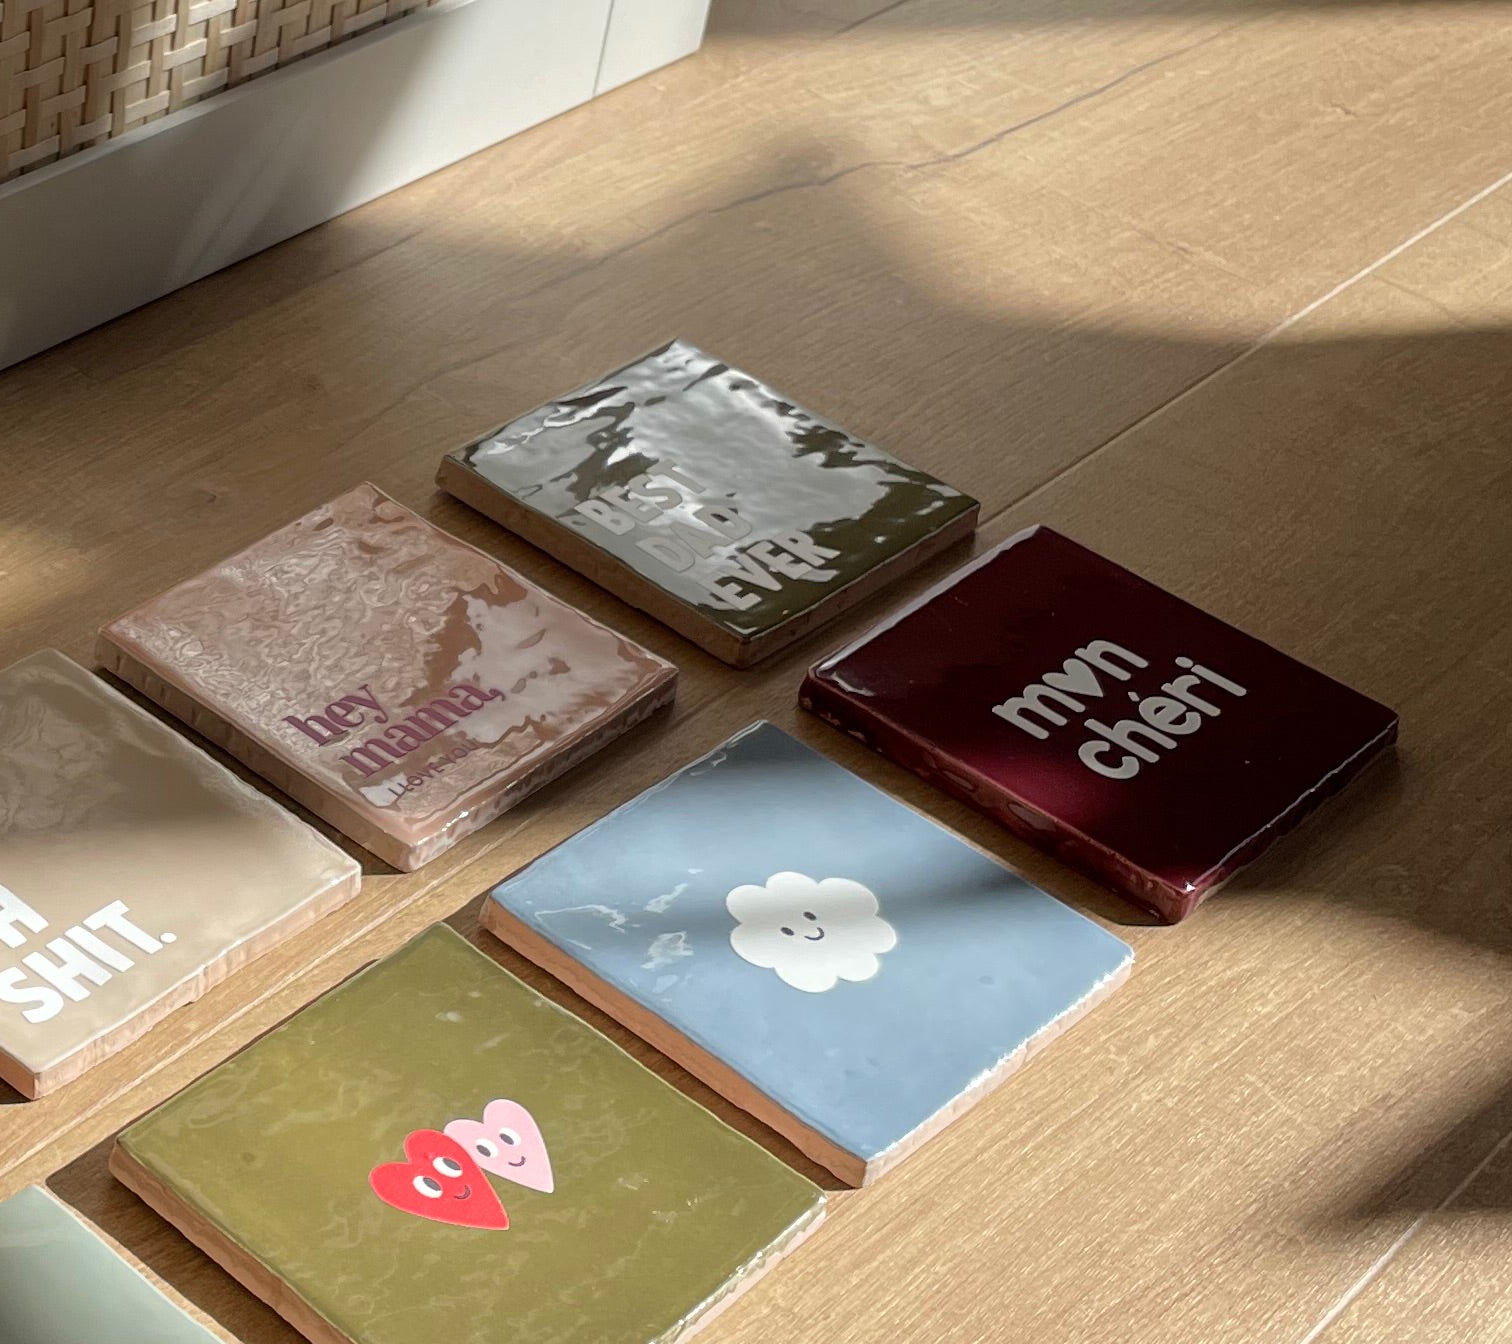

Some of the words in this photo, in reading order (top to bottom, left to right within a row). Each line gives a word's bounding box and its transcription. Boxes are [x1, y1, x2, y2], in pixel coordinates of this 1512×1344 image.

[573, 460, 706, 536] BEST
[635, 503, 753, 573] DAD
[699, 529, 840, 611] EVER
[283, 684, 389, 747] hey
[340, 683, 505, 777] mama,
[1078, 656, 1247, 780] chéri
